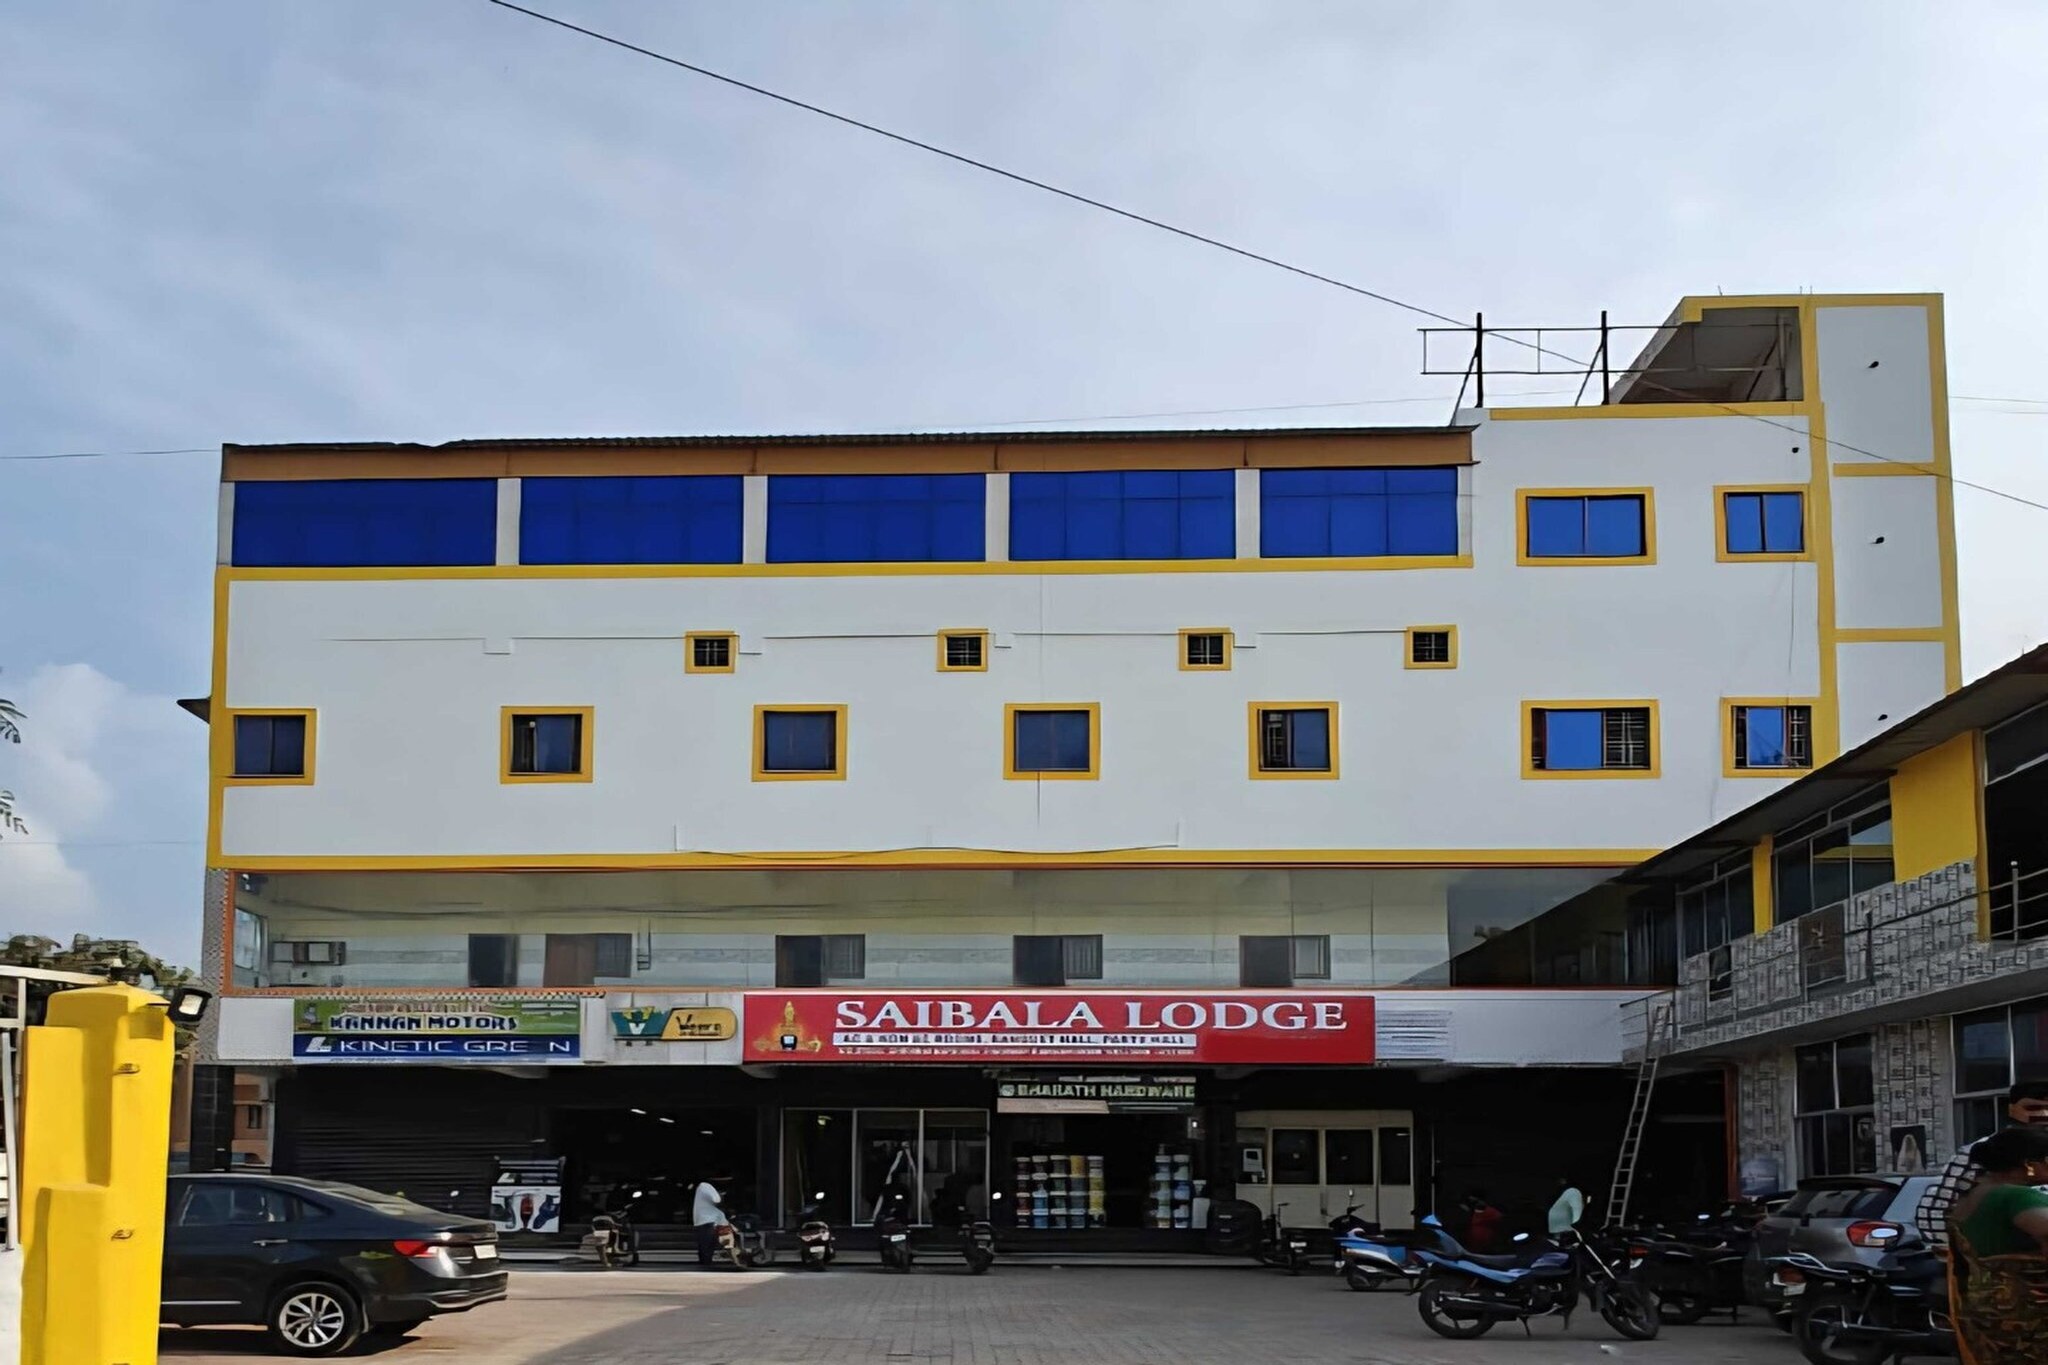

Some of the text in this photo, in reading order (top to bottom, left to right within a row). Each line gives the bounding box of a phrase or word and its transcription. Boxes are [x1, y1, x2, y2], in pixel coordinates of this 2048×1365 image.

[835, 1000, 1347, 1030] SAIBALA LODGE
[340, 1040, 453, 1053] KINETIC
